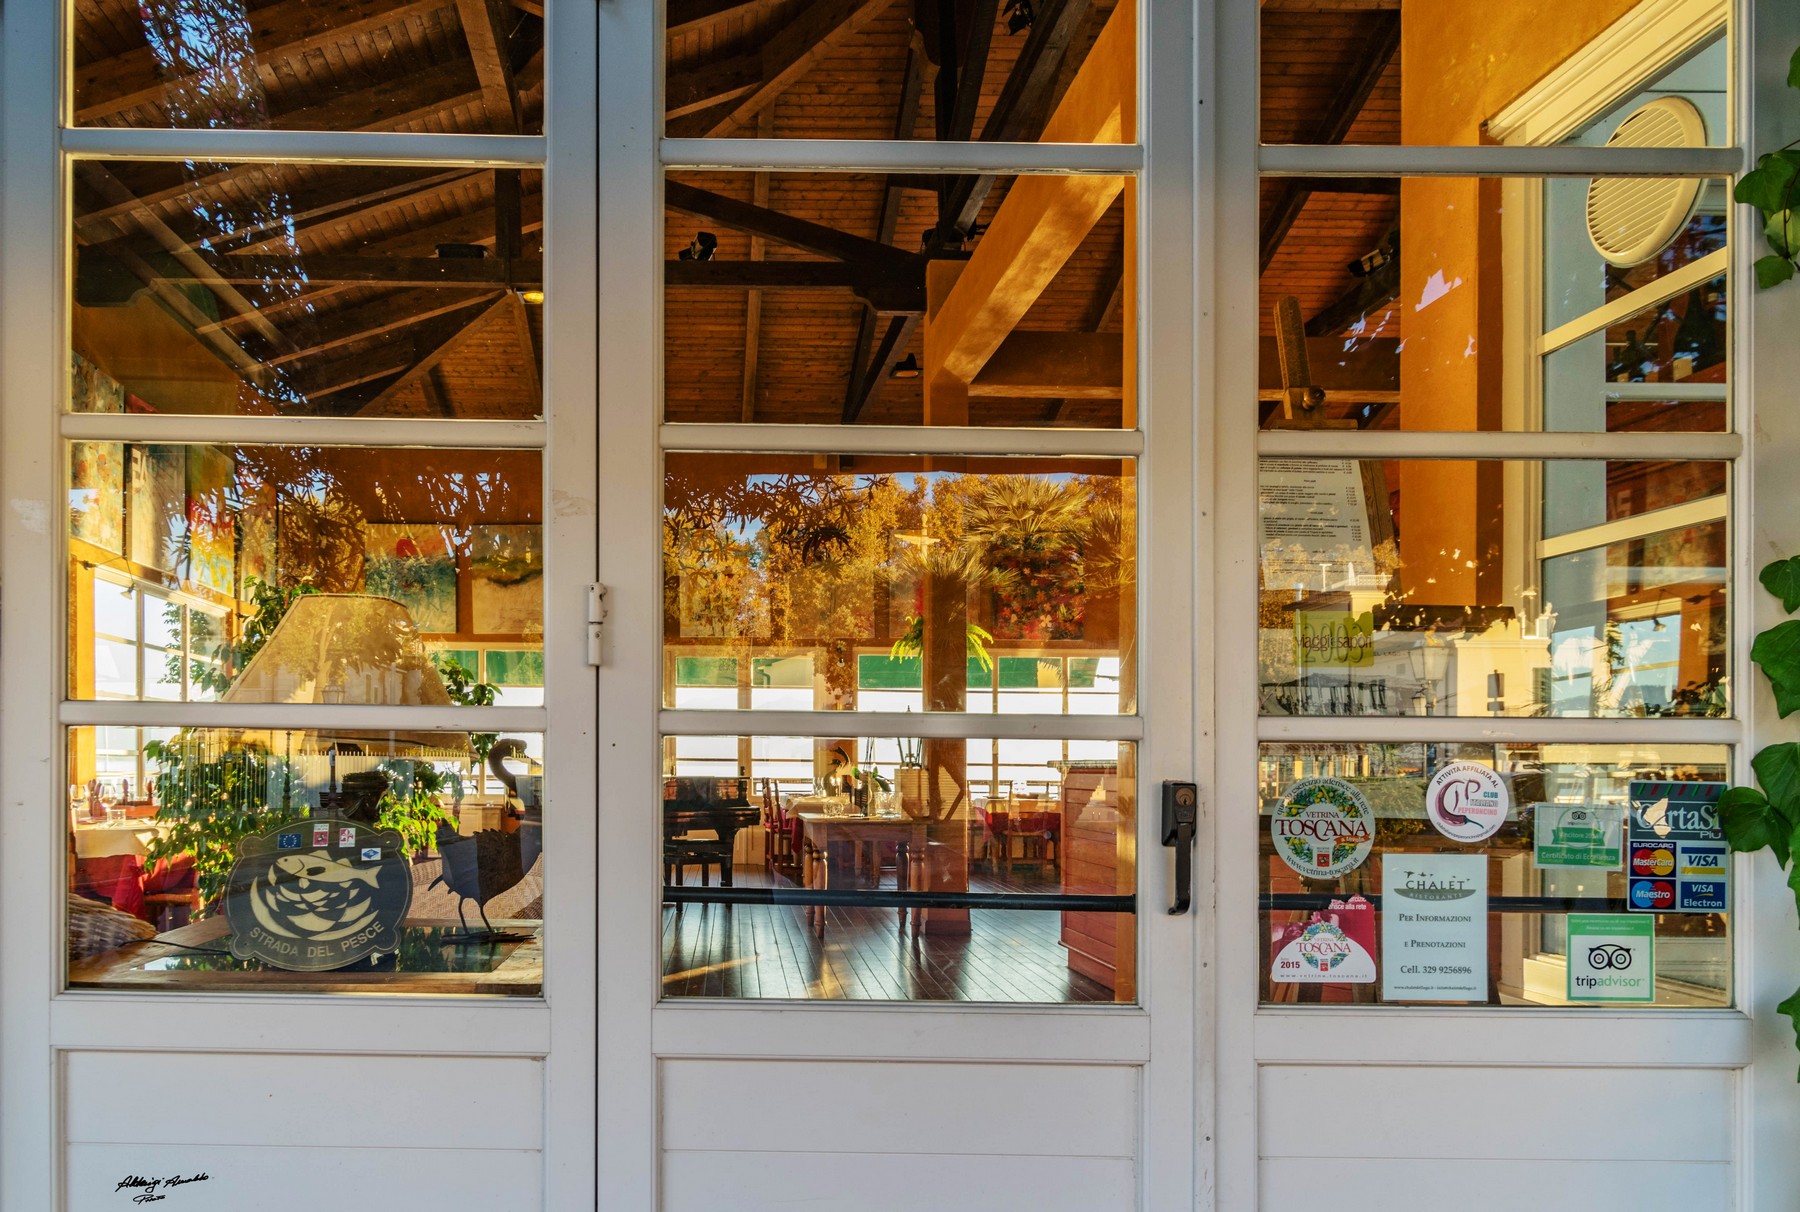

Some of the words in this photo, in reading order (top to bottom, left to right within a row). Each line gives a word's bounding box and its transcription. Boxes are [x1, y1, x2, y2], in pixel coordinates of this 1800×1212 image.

[1462, 766, 1492, 780] AFFILIATA
[1491, 780, 1499, 788] AL
[1322, 778, 1351, 792] aderisce
[1350, 788, 1362, 801] alla
[1359, 800, 1370, 815] rete
[1483, 791, 1499, 799] CLUB
[1306, 811, 1340, 819] VETRINA
[1458, 807, 1498, 816] PEPERONCINO
[1275, 819, 1368, 841] TOSCANA
[1633, 858, 1673, 866] MasterCard
[1688, 855, 1718, 867] VISA
[1406, 880, 1465, 890] CHALET
[1692, 884, 1714, 893] VISA
[1409, 892, 1462, 900] RISTORANTE
[1636, 890, 1671, 899] Maestro
[1683, 898, 1723, 907] Electron
[250, 927, 299, 957] STRADA
[307, 946, 335, 958] DEL
[340, 921, 385, 952] PESCE
[1296, 942, 1351, 956] TOSCANA
[1281, 961, 1300, 969] 2015
[1400, 965, 1420, 973] Cell.
[1422, 966, 1437, 974] 329
[1438, 966, 1472, 974] 9256896
[1576, 975, 1641, 989] tripadvisor
